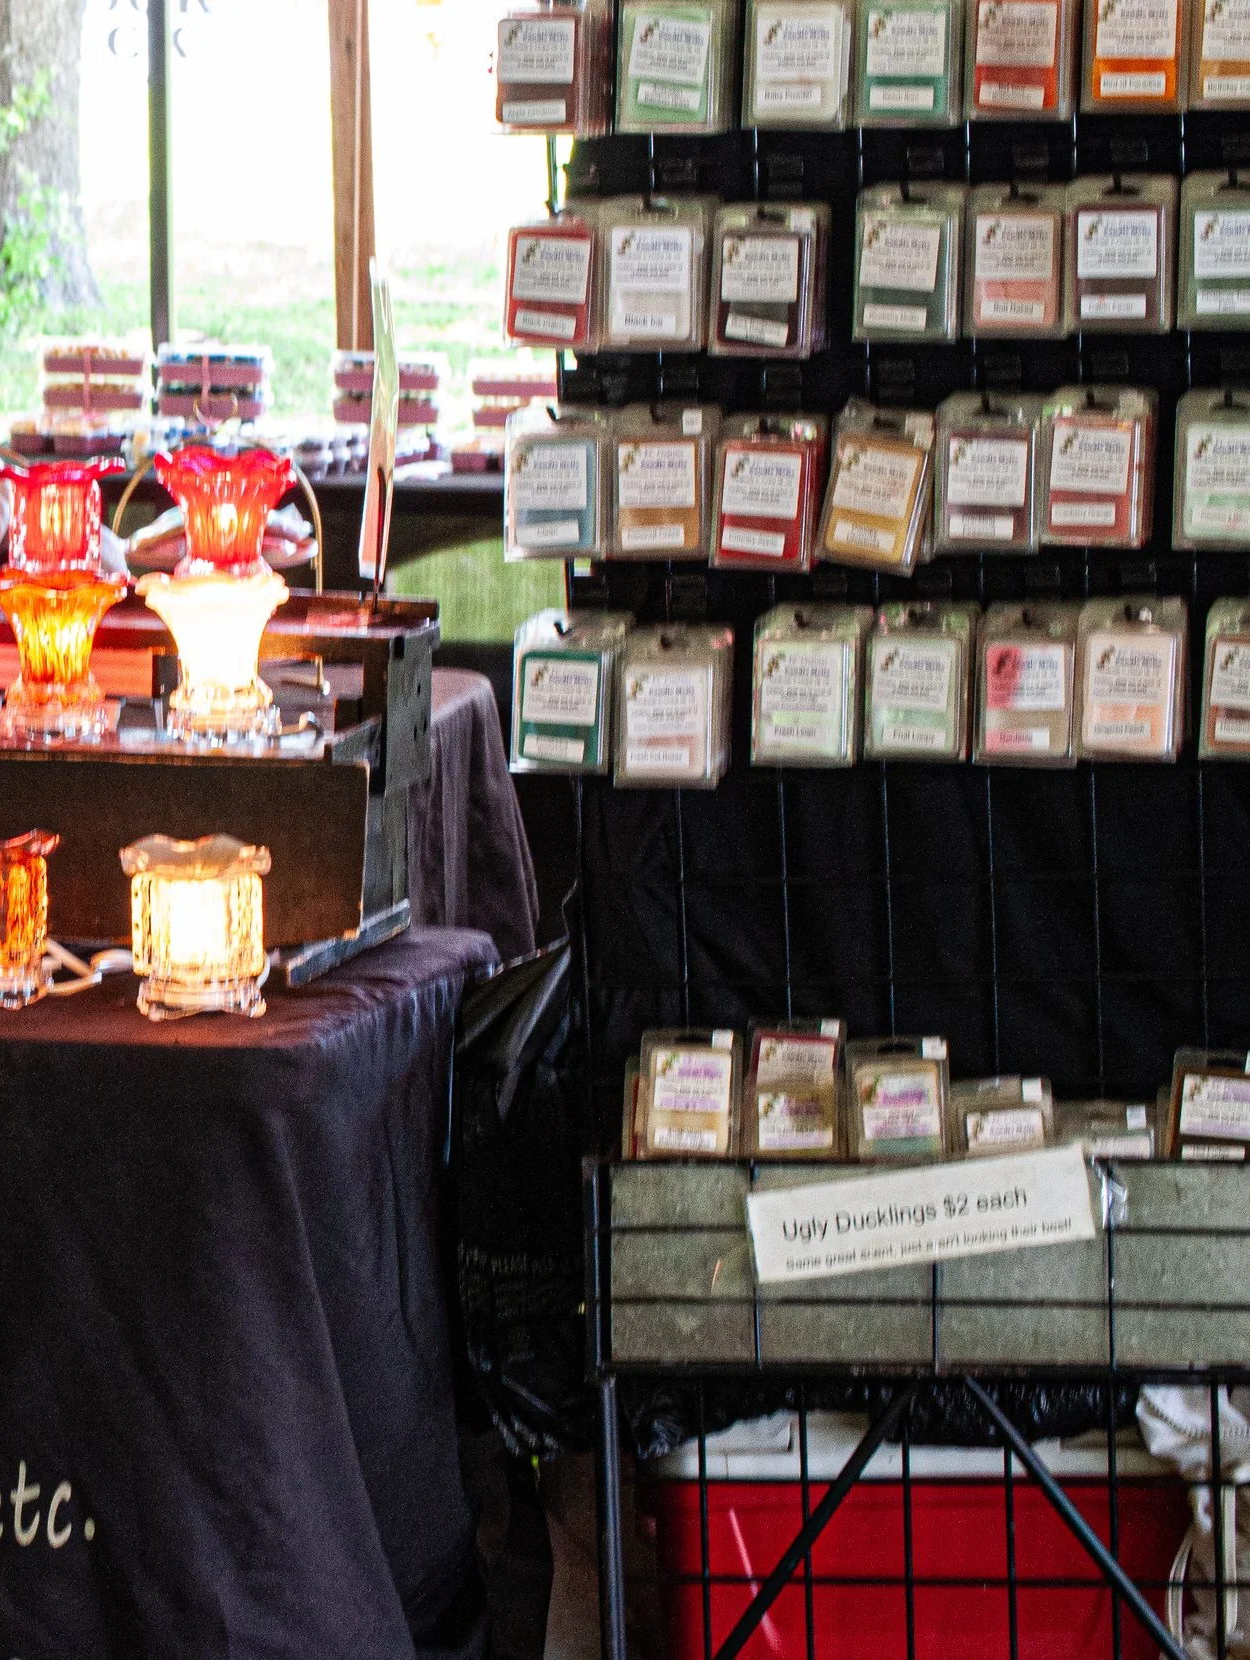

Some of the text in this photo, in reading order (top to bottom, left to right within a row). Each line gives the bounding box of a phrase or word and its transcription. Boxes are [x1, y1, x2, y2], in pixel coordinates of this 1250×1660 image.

[781, 1186, 1028, 1243] Ugly Ducklings $2 each
[785, 1255, 823, 1272] Same
[824, 1250, 857, 1269] great
[899, 1241, 923, 1257] just
[962, 1229, 1008, 1248] looking
[1010, 1223, 1039, 1239] their
